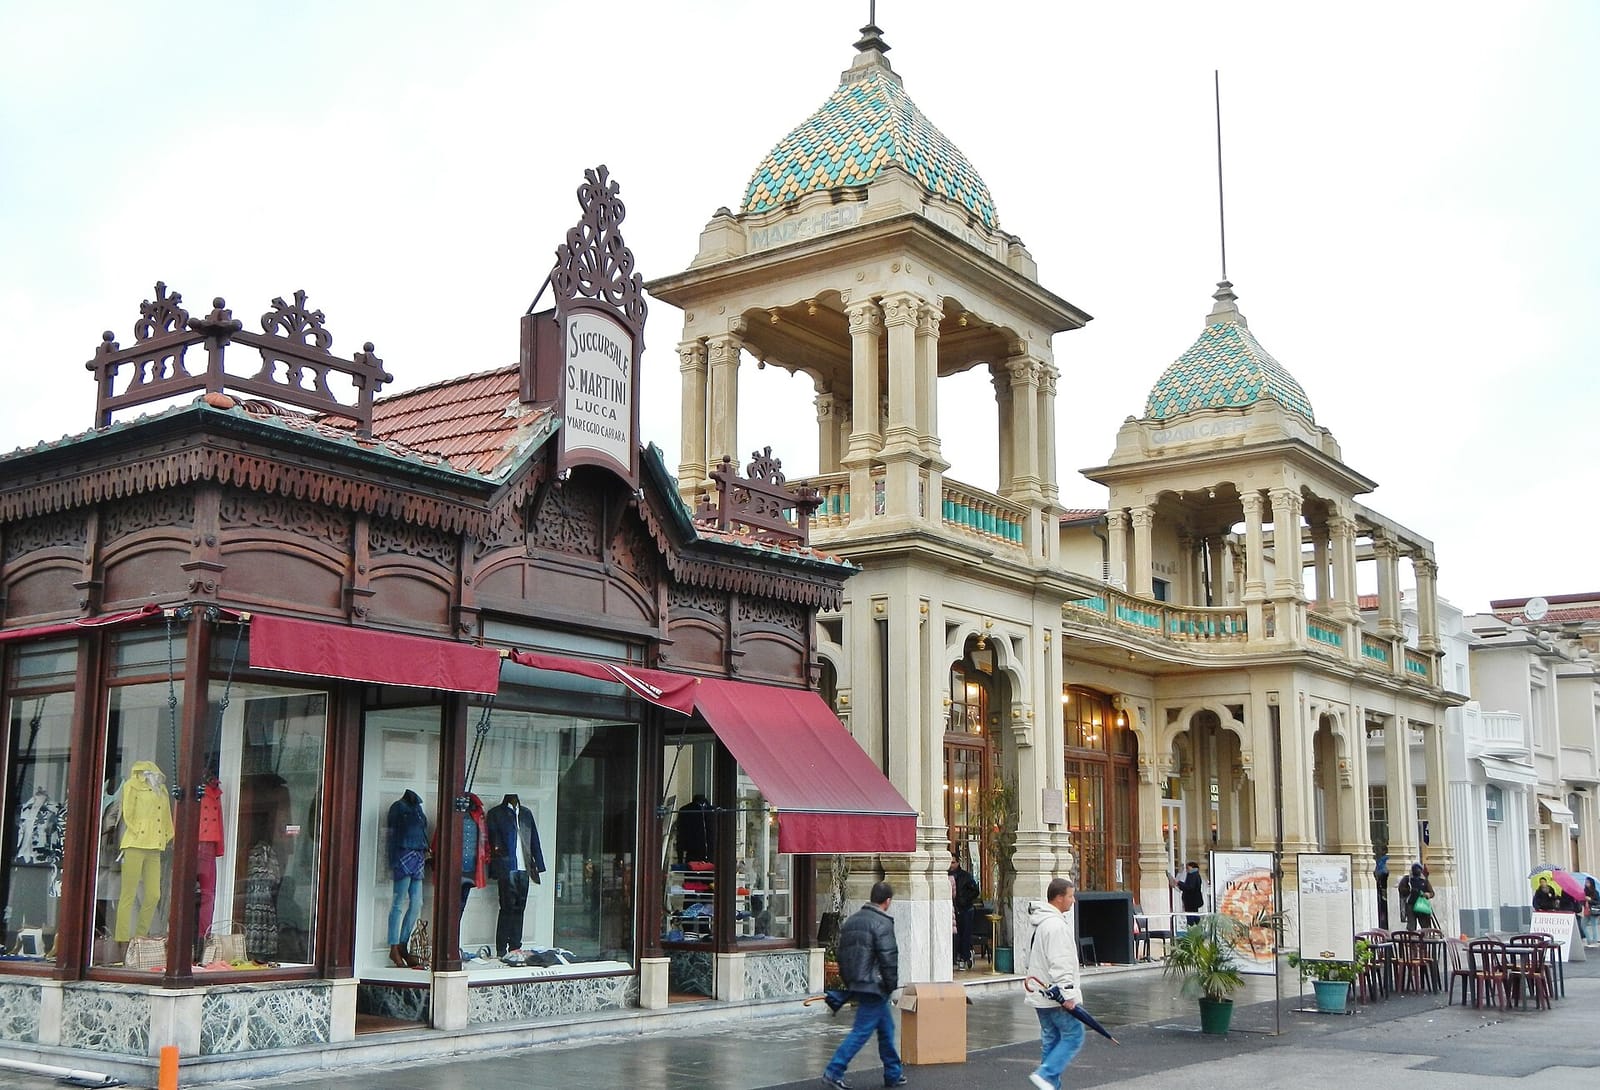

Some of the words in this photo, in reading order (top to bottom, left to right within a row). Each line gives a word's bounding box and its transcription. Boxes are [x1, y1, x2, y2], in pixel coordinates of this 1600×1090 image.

[570, 321, 628, 378] SUCCURSALE
[575, 398, 617, 421] LUCCA
[600, 425, 626, 444] CARRARA
[1226, 881, 1258, 891] PIZZA
[1534, 916, 1570, 926] LIBRERIA
